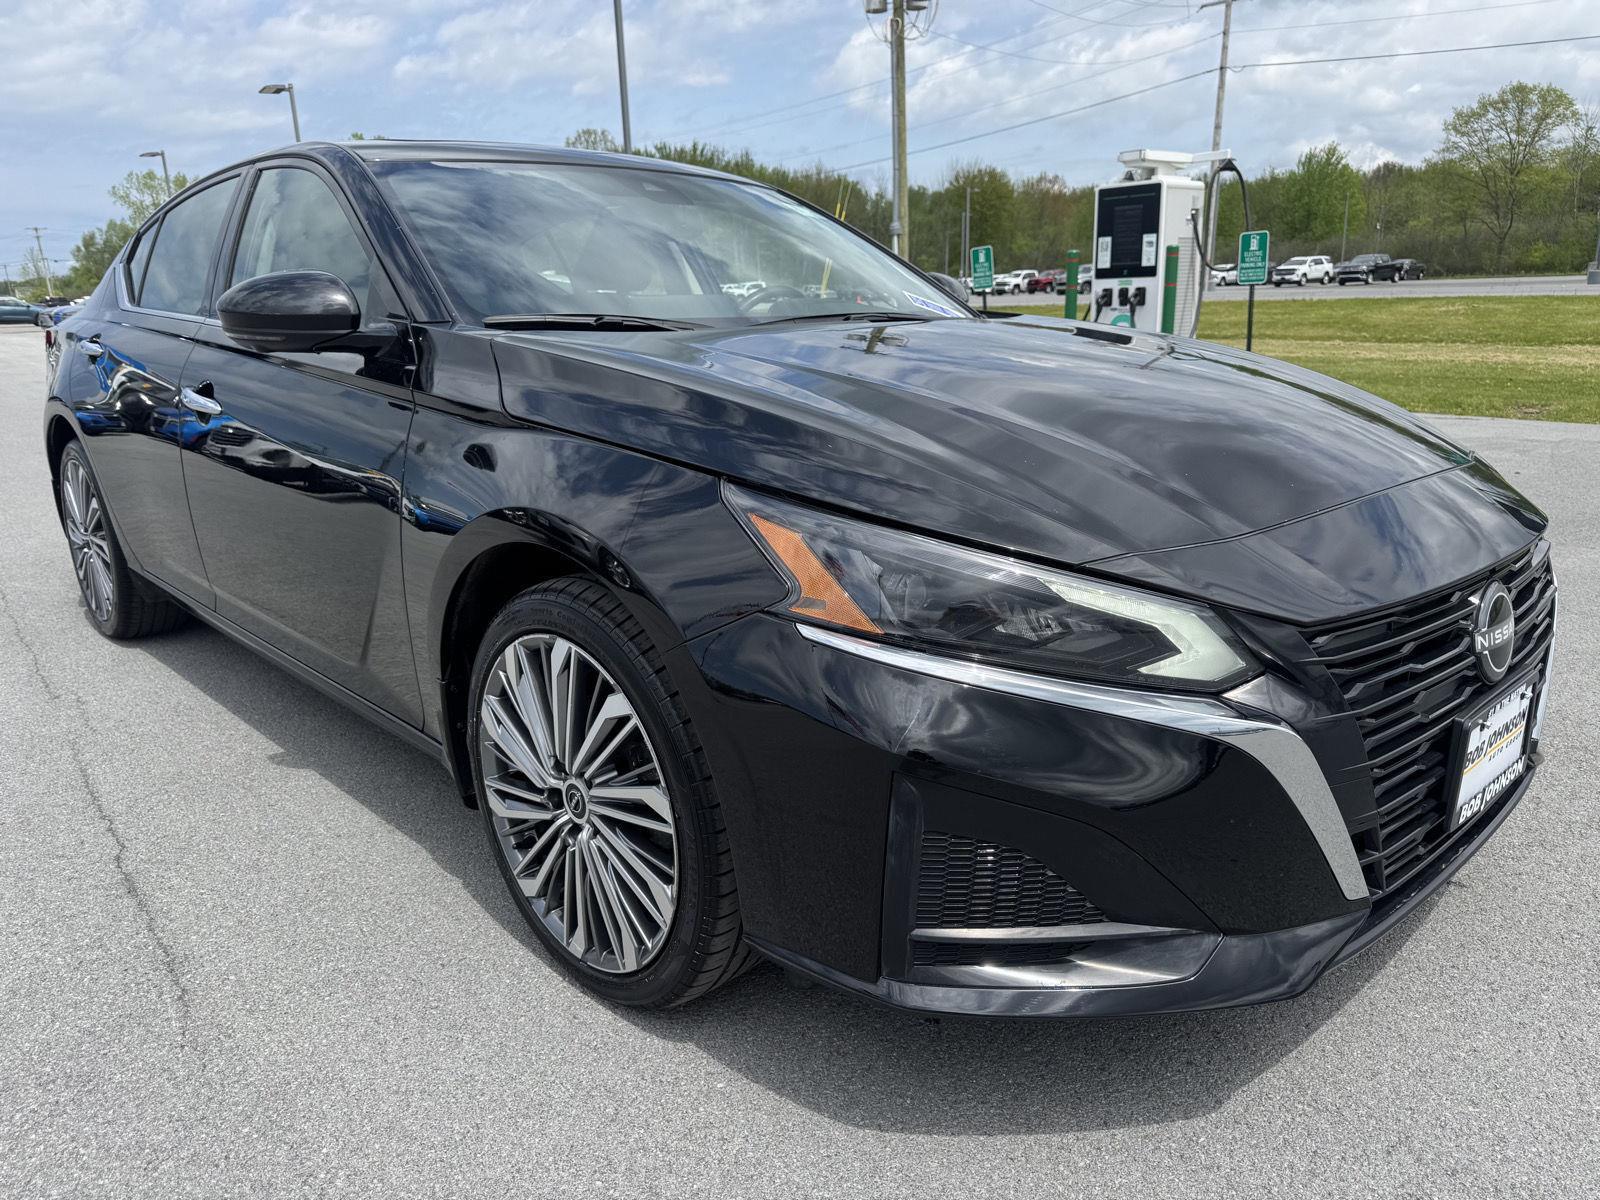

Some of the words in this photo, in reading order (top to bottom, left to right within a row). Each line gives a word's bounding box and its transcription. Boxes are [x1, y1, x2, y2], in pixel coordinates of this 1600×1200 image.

[1477, 621, 1513, 650] NISSA
[1465, 741, 1486, 767] BOB
[1483, 706, 1528, 758] JOHNSON
[1488, 743, 1504, 762] AUTO
[1458, 793, 1482, 825] BOB
[1480, 755, 1526, 812] JOHNSON
